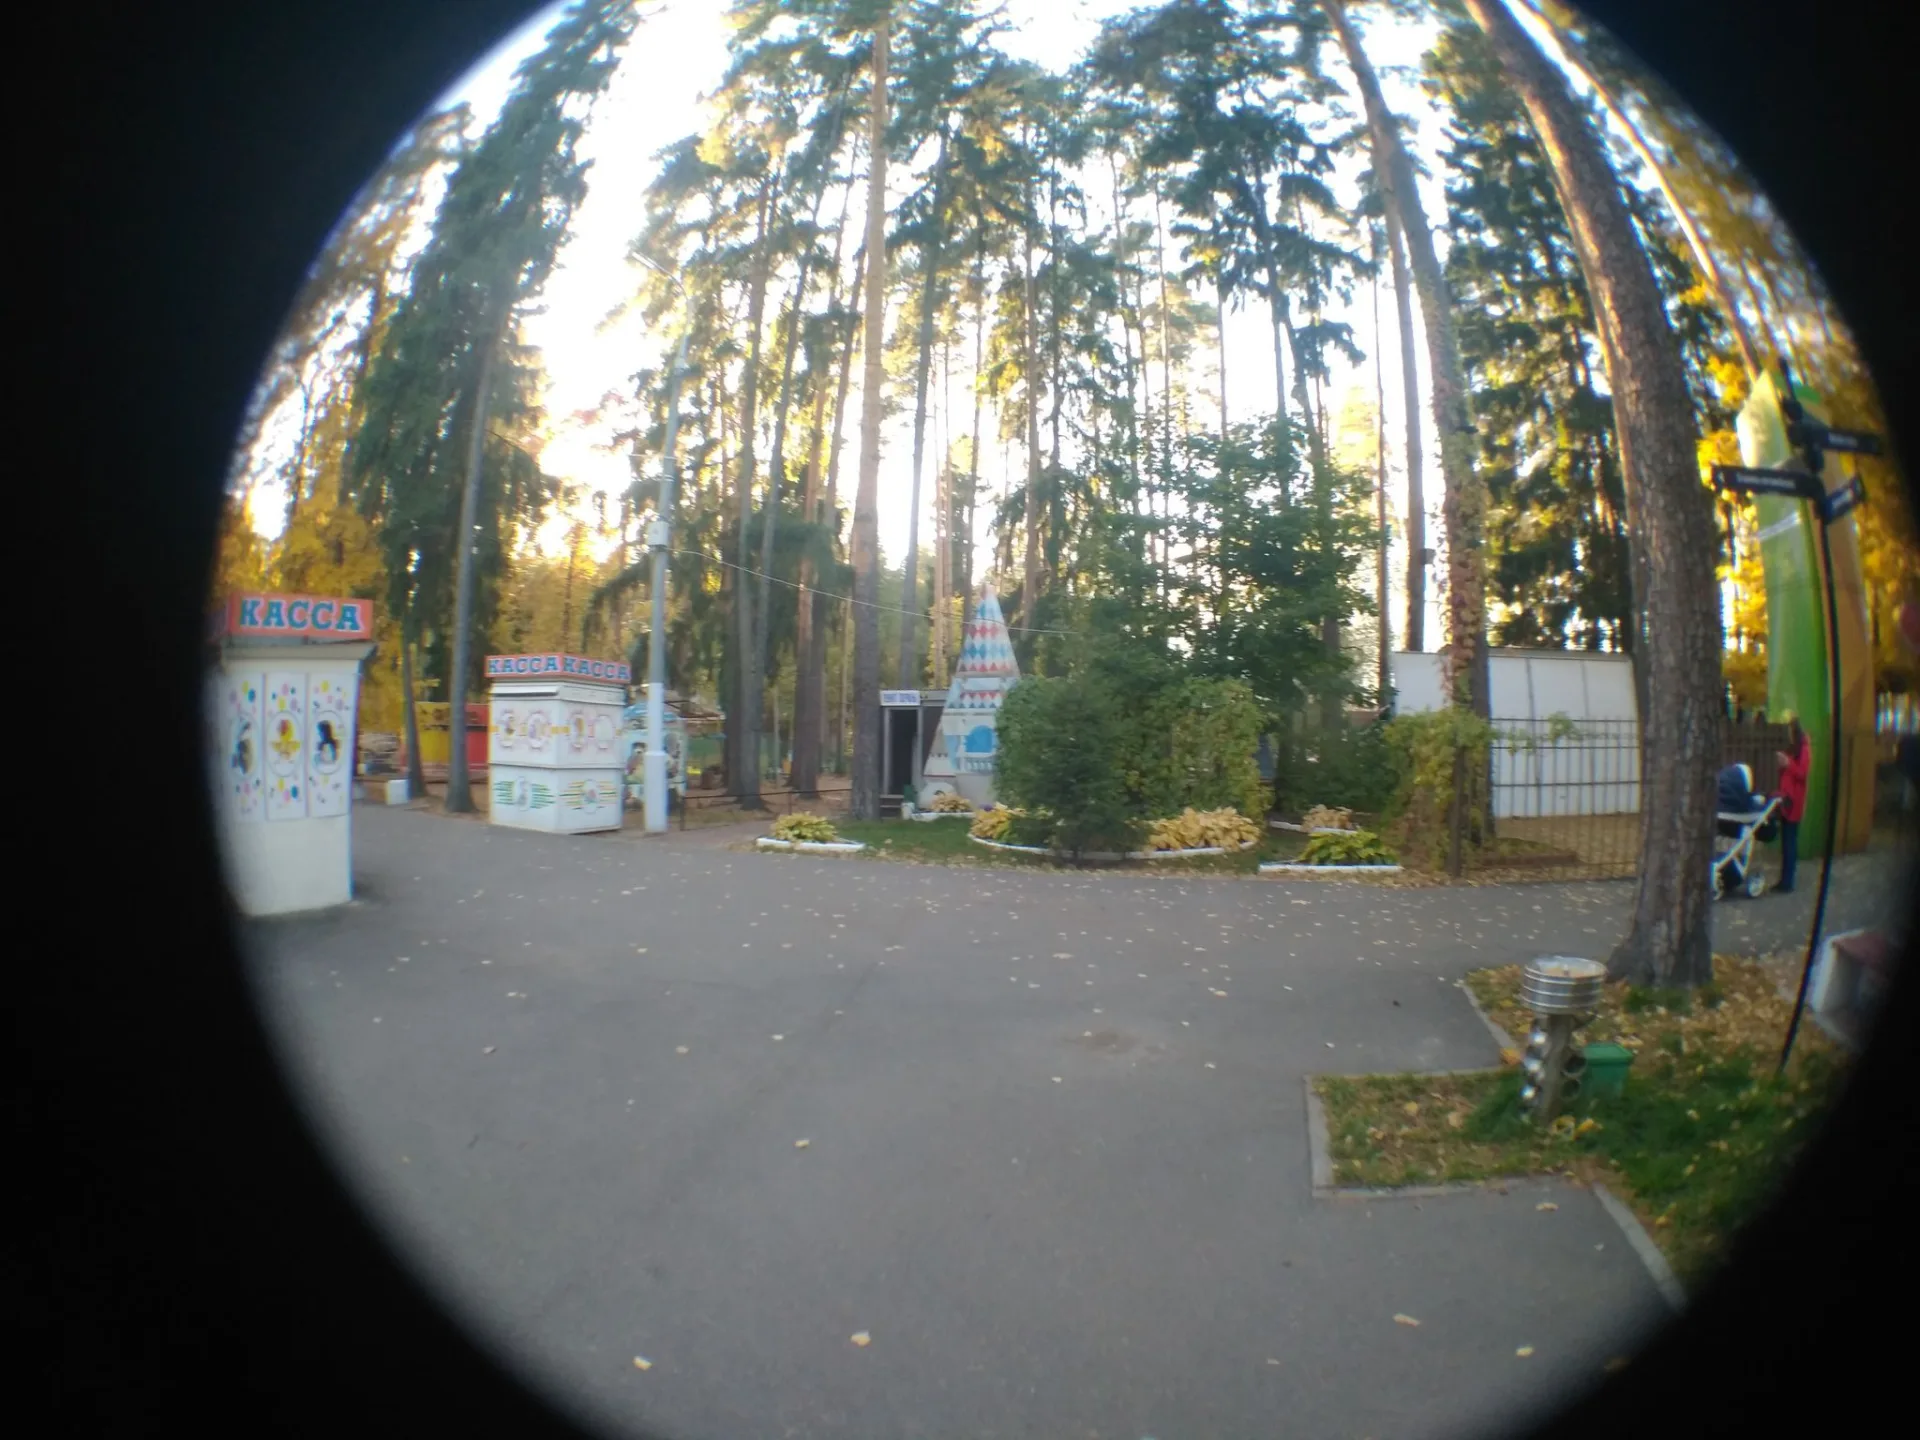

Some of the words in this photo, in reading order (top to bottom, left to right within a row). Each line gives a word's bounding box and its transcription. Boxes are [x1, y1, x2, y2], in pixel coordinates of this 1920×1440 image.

[241, 599, 360, 631] КАССА
[488, 656, 558, 673] КАССА
[564, 657, 629, 679] КАССА
